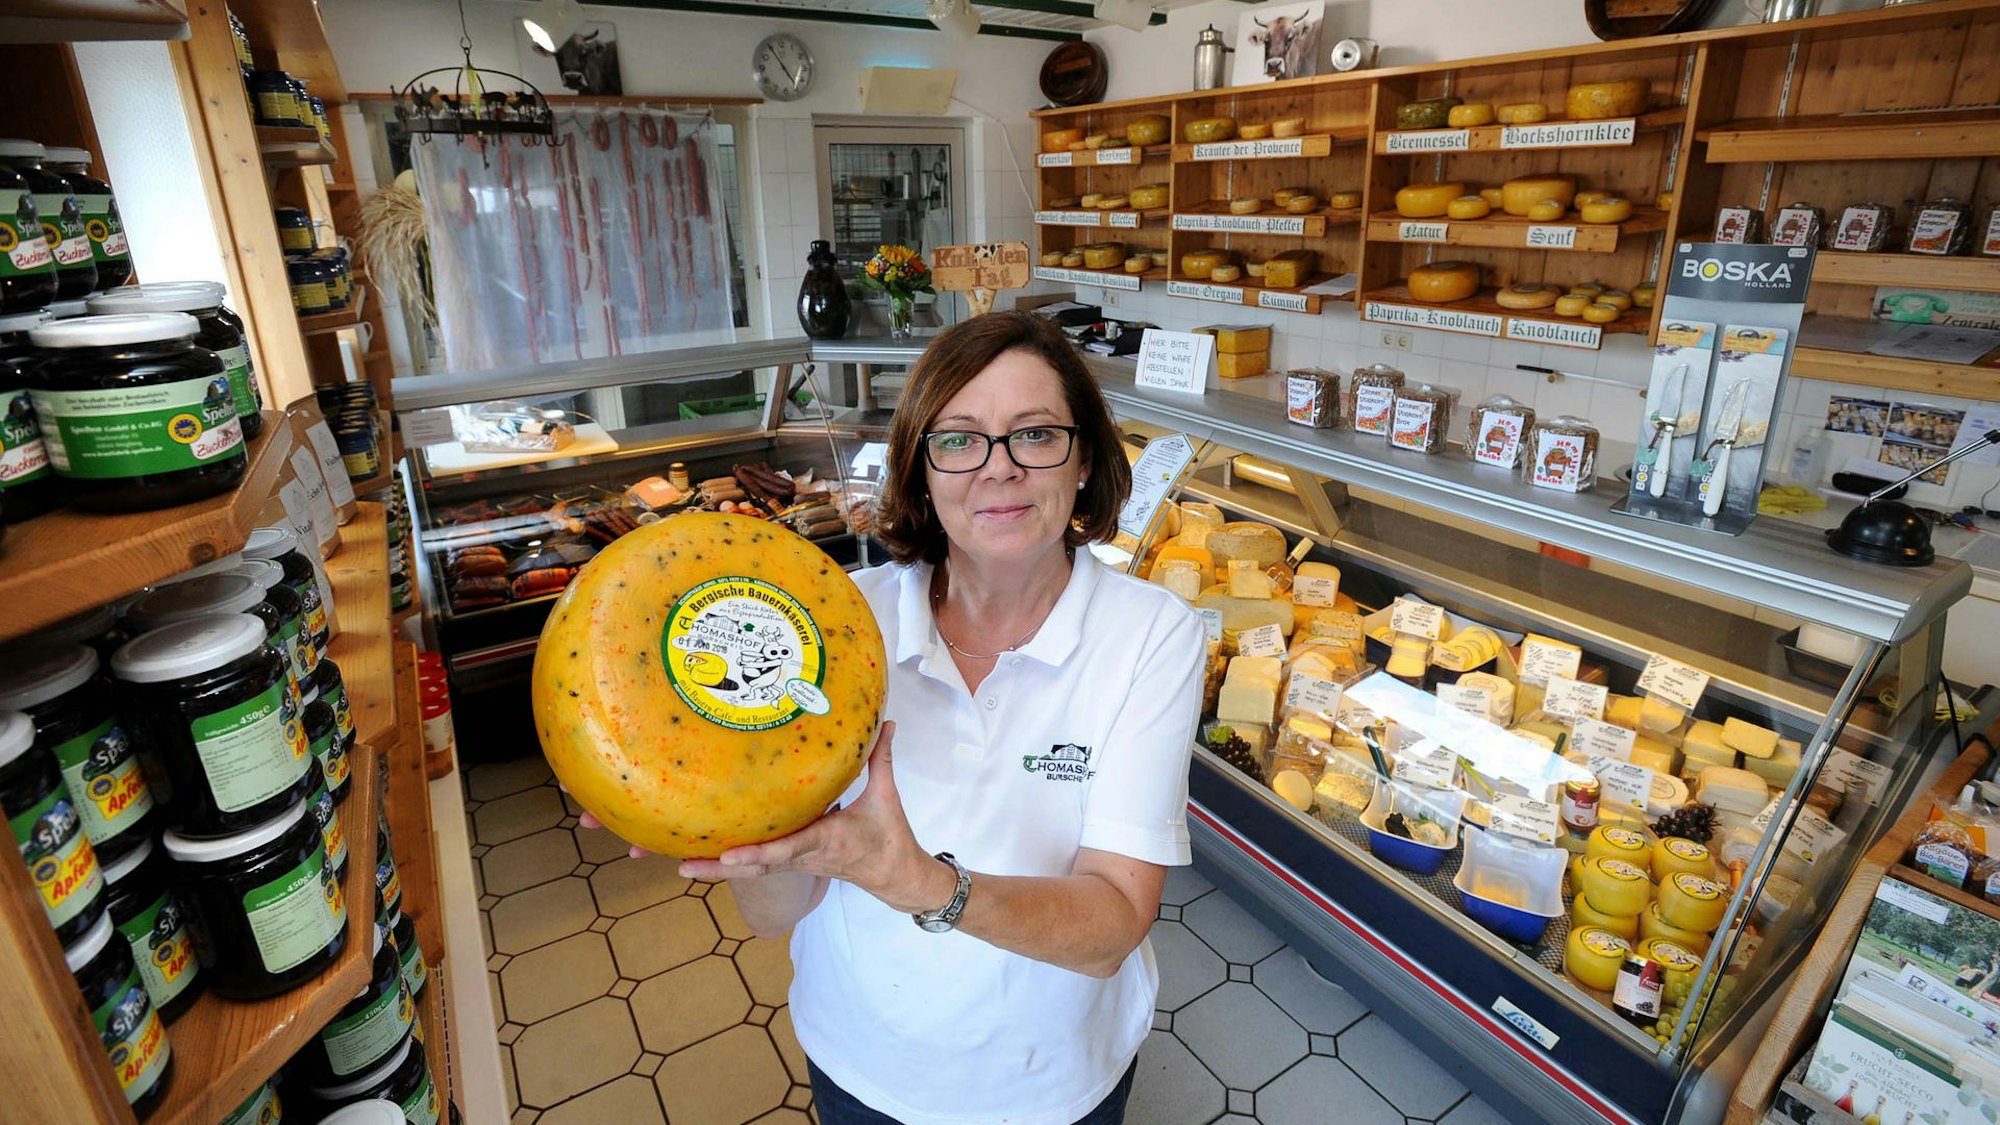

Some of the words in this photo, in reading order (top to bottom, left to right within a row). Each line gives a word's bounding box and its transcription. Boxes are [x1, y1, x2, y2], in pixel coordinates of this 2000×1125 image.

[1389, 131, 1467, 150] Brennessel
[1505, 124, 1631, 145] Bockshornklee
[1233, 144, 1249, 156] der
[1253, 141, 1300, 157] Provence
[1404, 224, 1443, 240] Natur
[1530, 227, 1573, 246] Senf
[1682, 258, 1792, 283] BOSKA
[1168, 282, 1243, 302] Tomate-Oregano
[1744, 281, 1791, 289] HOLLAND
[1511, 320, 1598, 347] Knoblauch
[1150, 339, 1166, 349] HIER
[1170, 340, 1191, 350] BITTE
[1147, 352, 1168, 361] KEINE
[1171, 354, 1192, 364] WARE
[1146, 365, 1184, 376] ABSTELLEN
[1144, 376, 1168, 386] VIELEN
[1170, 377, 1190, 388] DANK
[689, 584, 745, 613] Bergische
[748, 588, 814, 647] Bauernkäserei
[689, 690, 714, 713] Bauern
[736, 715, 751, 725] und
